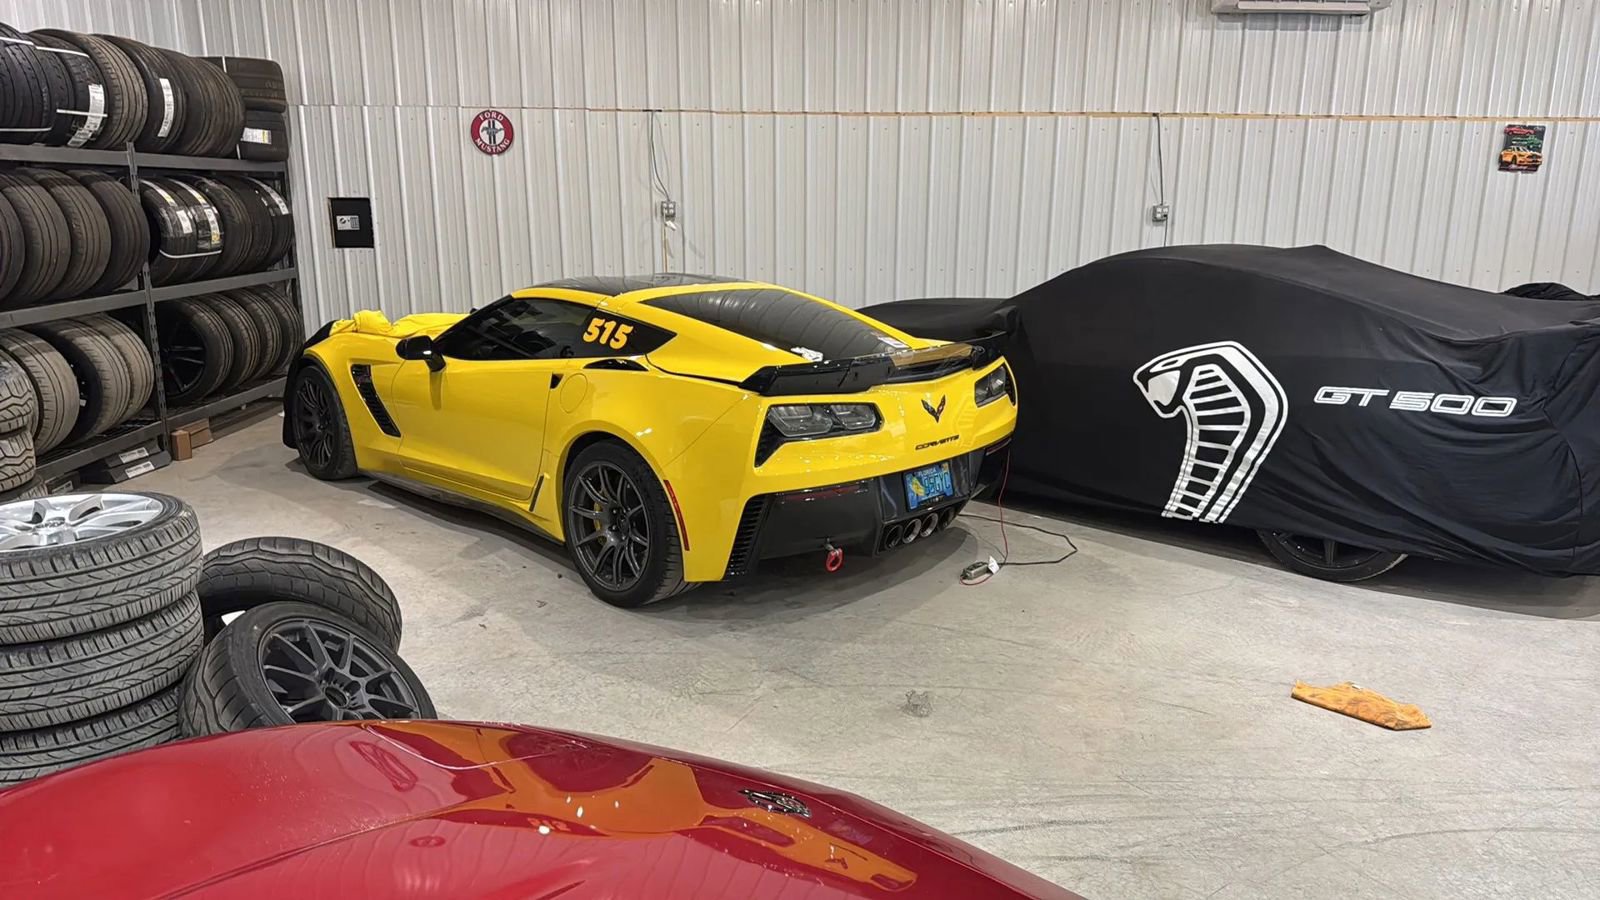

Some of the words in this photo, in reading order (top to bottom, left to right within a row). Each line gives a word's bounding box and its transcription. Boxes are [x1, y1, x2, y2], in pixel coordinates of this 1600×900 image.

[479, 112, 504, 121] FORD
[475, 138, 510, 153] MUSTANG
[582, 317, 634, 350] 515
[1314, 386, 1390, 407] GT
[1389, 391, 1517, 417] 500
[915, 434, 959, 450] CORVETTE
